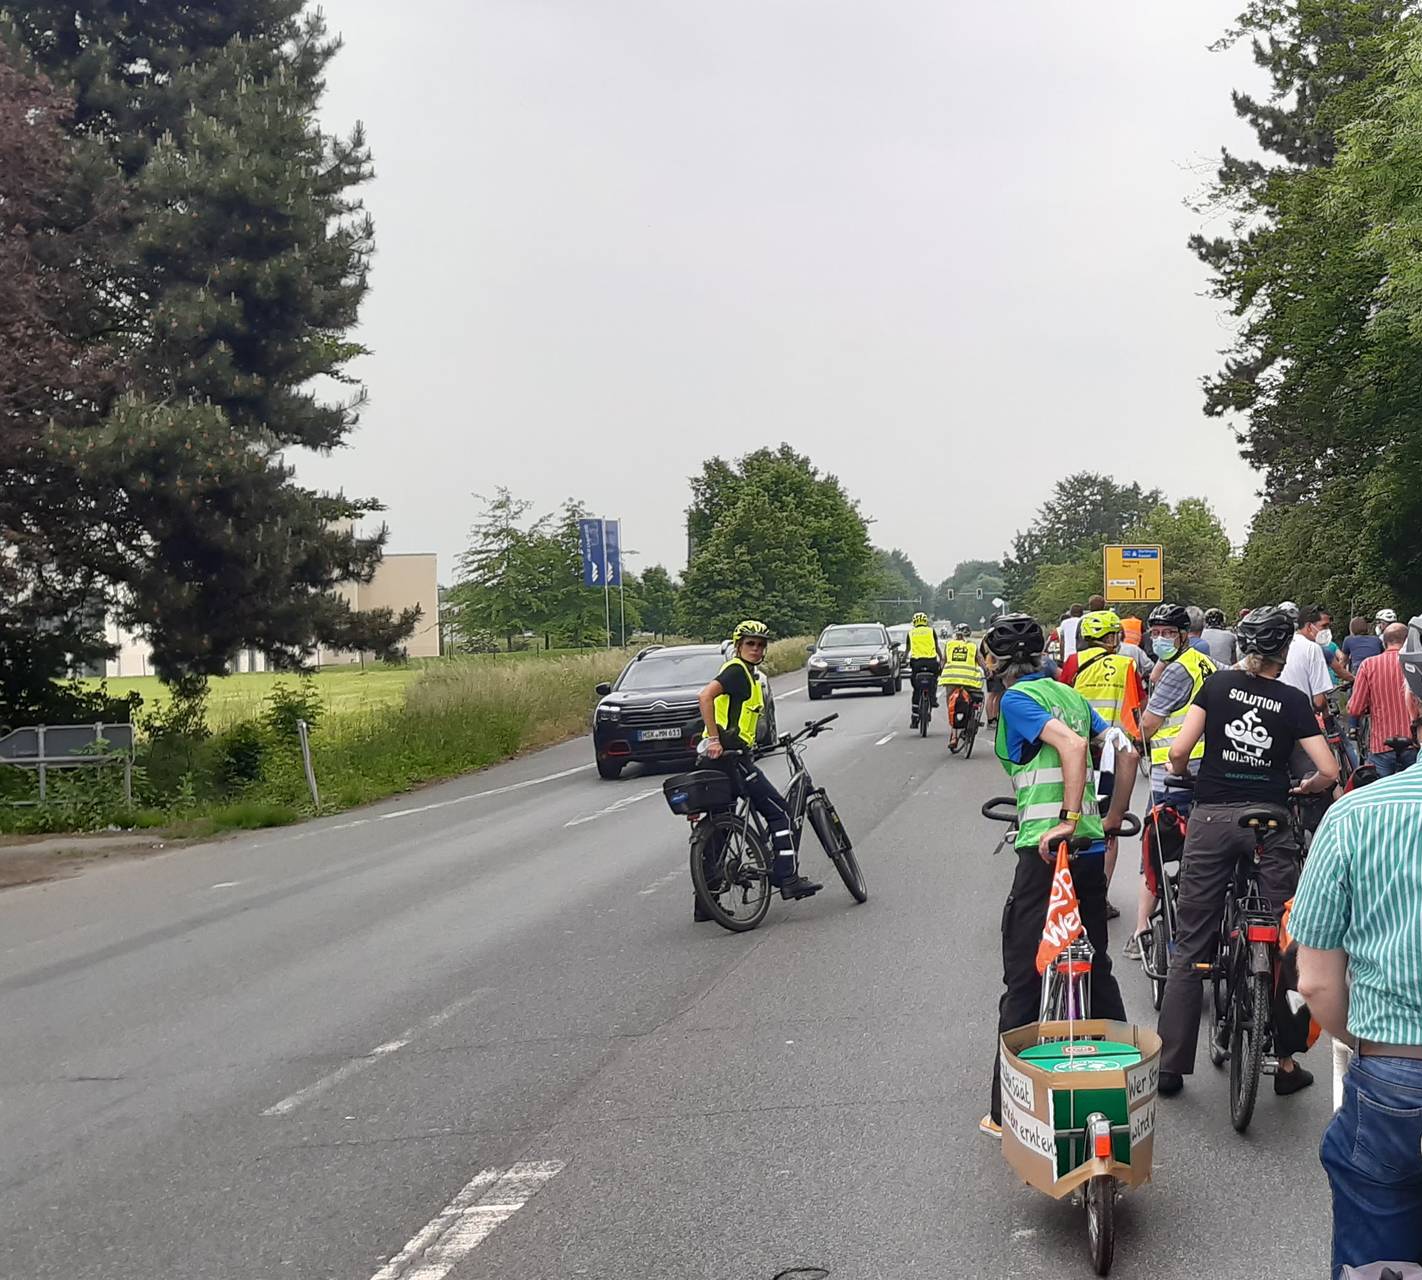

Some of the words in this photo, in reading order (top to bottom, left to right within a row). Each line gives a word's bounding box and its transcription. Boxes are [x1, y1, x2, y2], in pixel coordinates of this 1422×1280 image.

[1228, 688, 1282, 713] SOLUTION
[1128, 1073, 1147, 1101] Wer
[1131, 1106, 1150, 1141] wird
